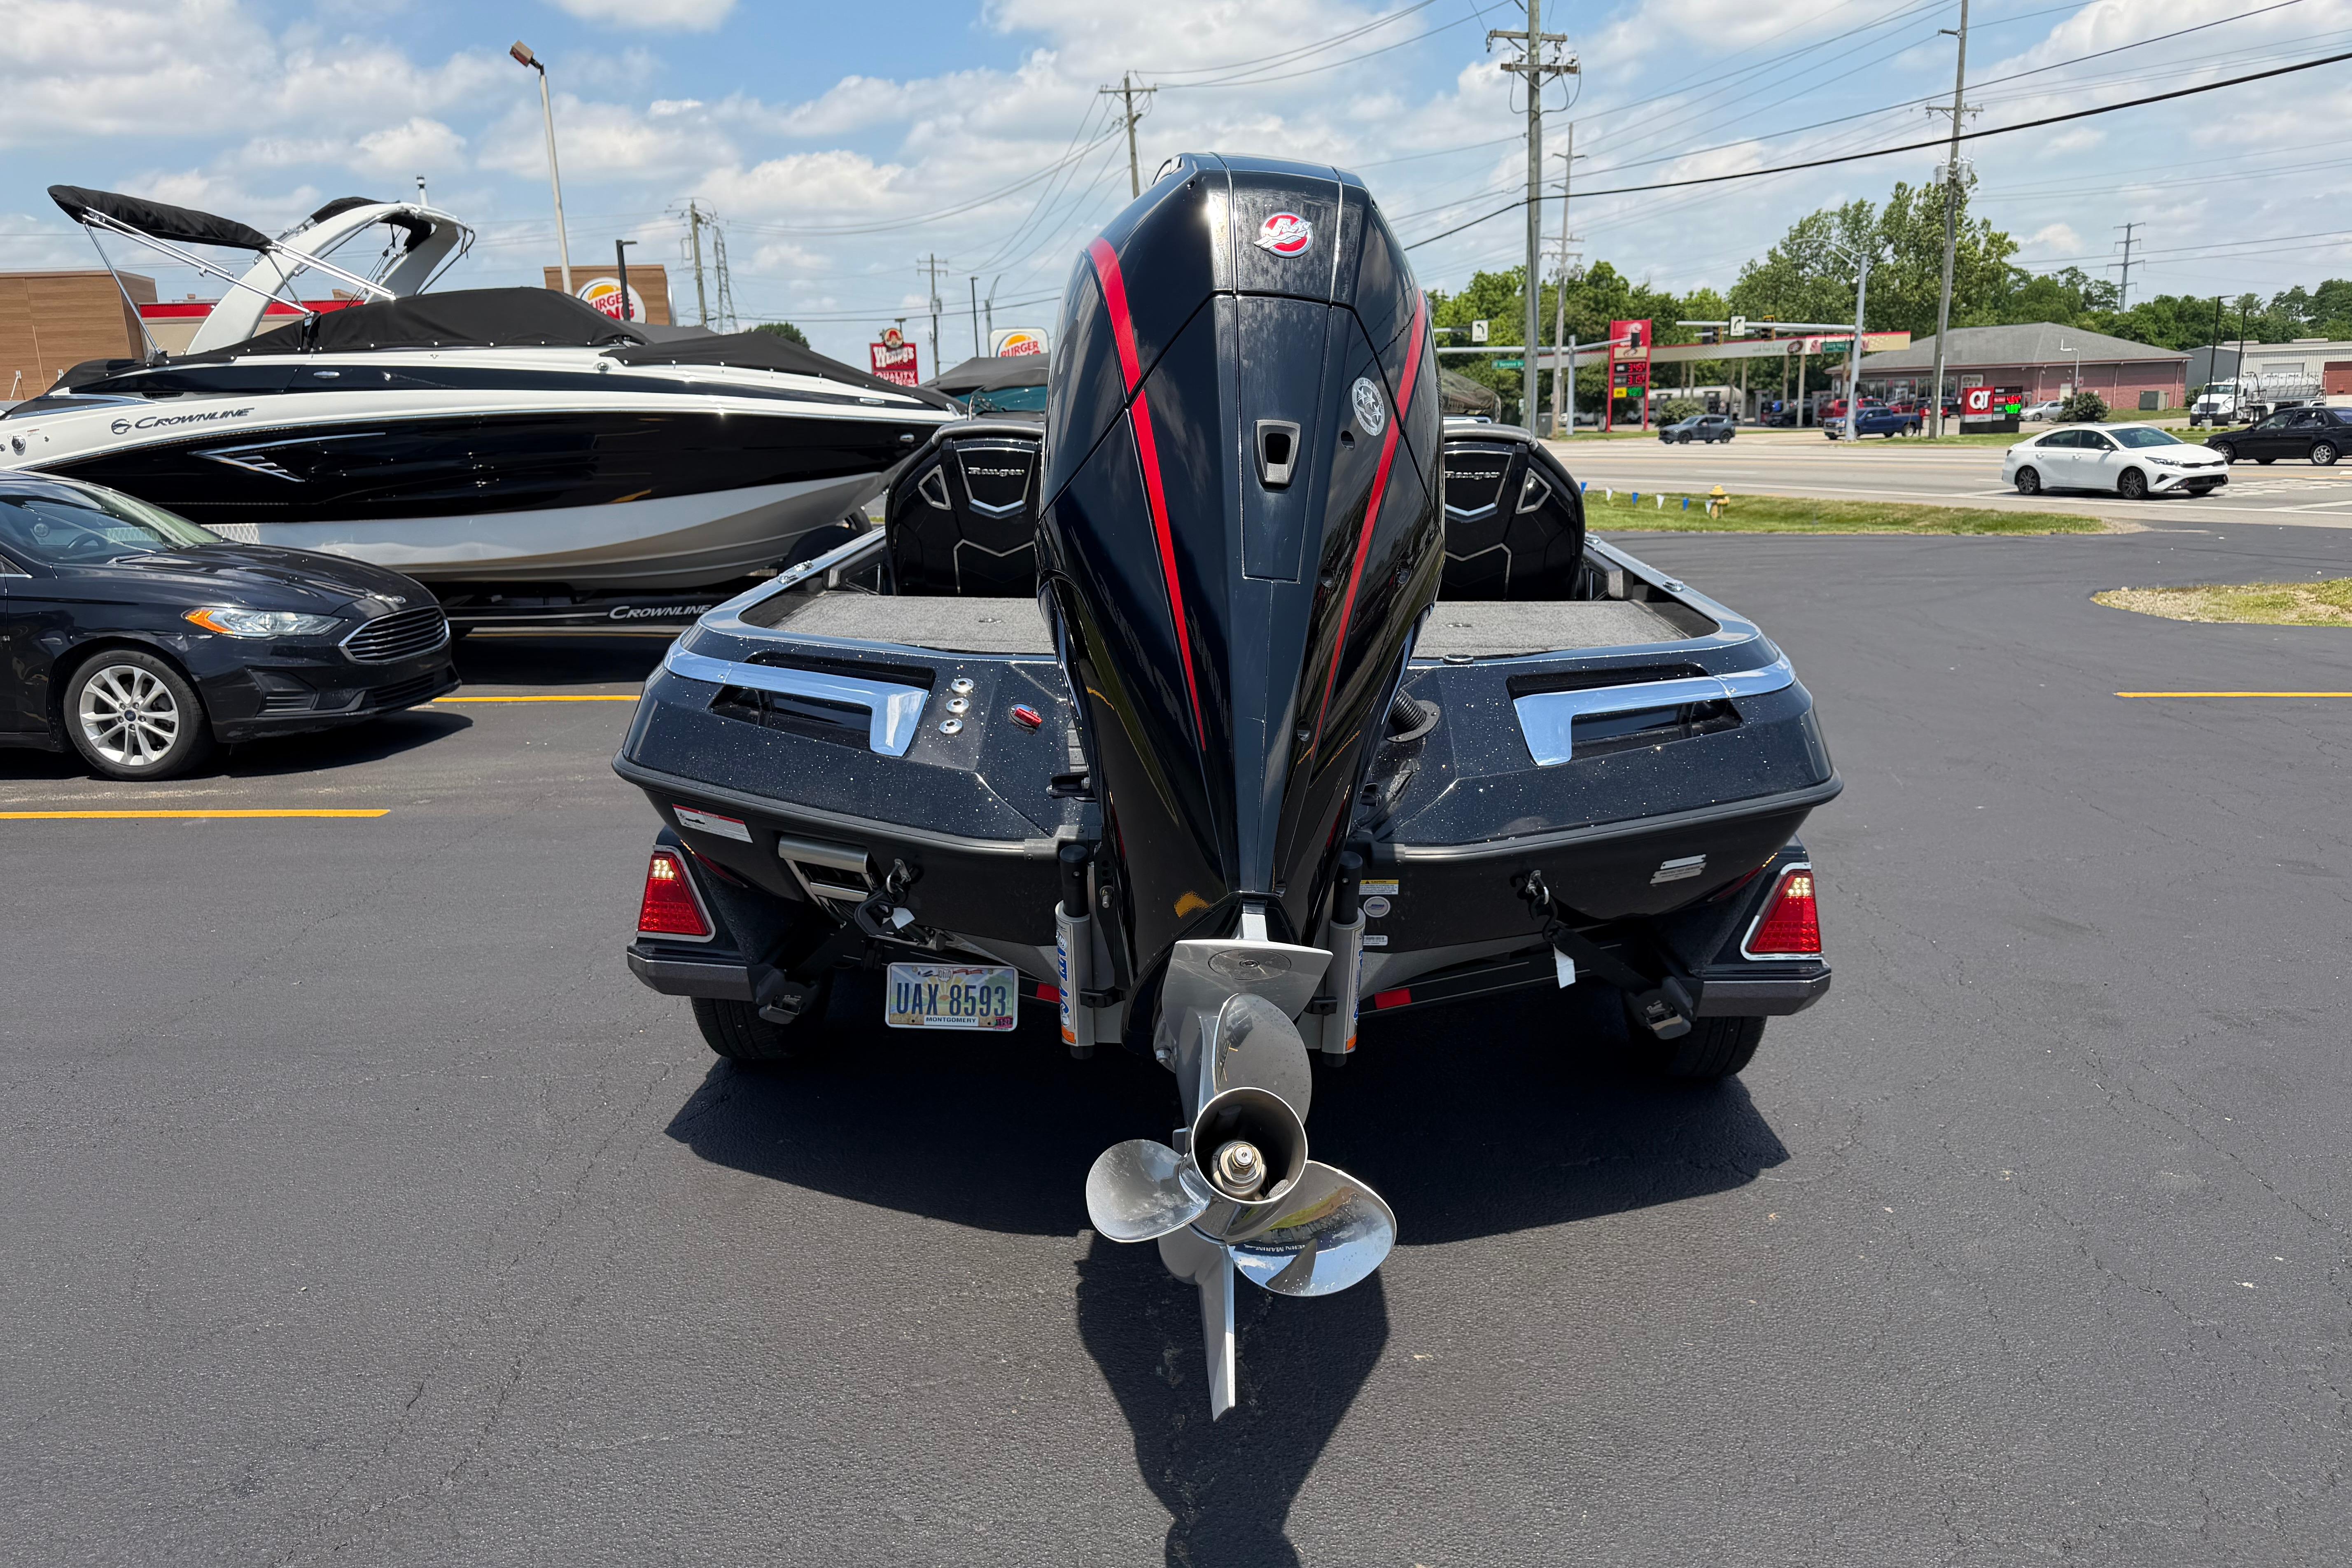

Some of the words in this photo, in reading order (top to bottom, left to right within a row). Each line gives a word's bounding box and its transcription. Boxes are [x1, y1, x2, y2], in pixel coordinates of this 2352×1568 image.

[1359, 380, 1374, 391] ULTRA
[1969, 390, 1991, 410] QT
[135, 407, 255, 429] CROWNLINE
[968, 467, 1025, 477] Ranger
[1445, 471, 1501, 480] Ranger
[609, 604, 712, 619] CROWNLINE
[939, 969, 951, 979] Ohio
[896, 982, 939, 1015] UAX
[949, 984, 1007, 1017] 8593
